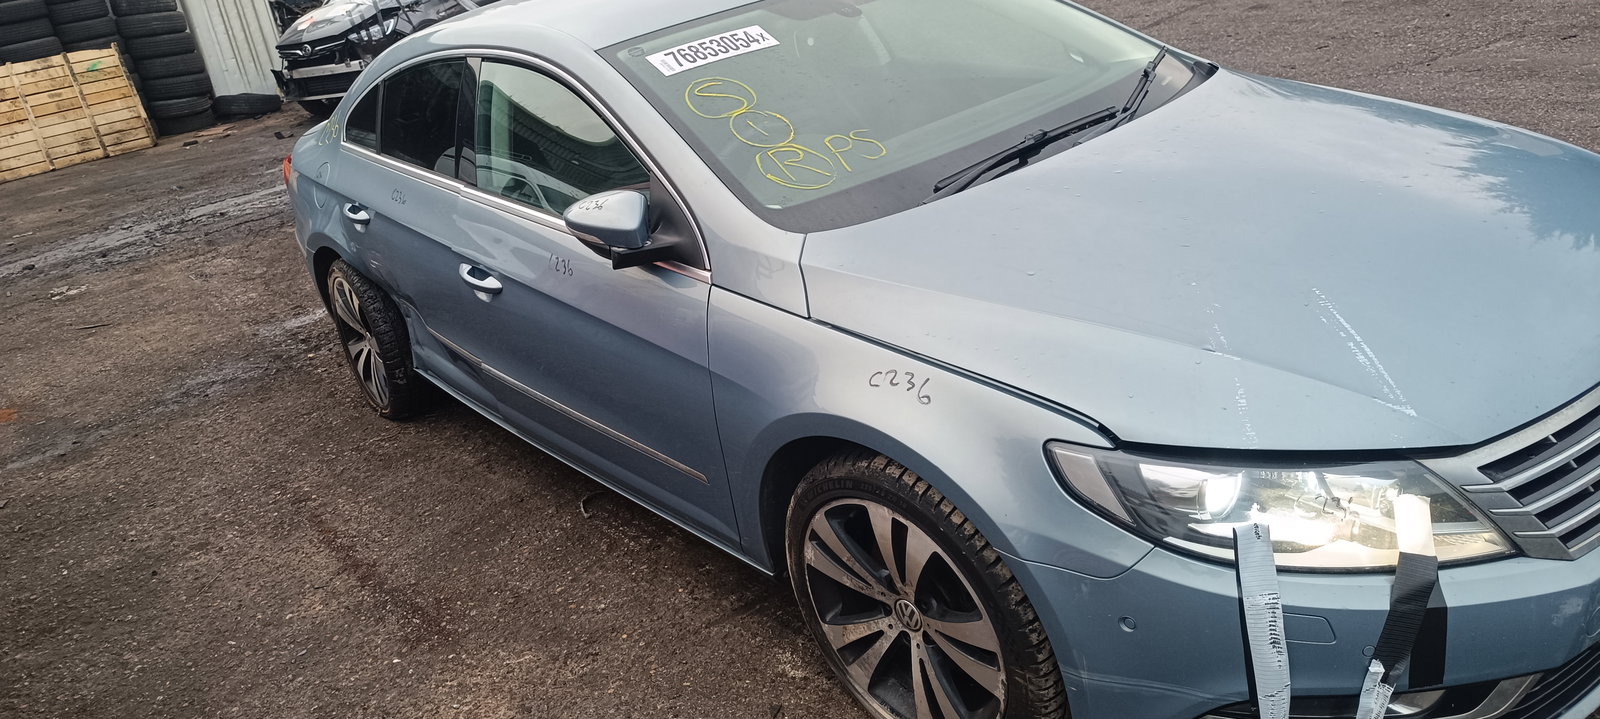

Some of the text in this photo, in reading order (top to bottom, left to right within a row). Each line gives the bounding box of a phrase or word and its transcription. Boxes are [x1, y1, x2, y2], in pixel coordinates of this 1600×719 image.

[664, 30, 761, 67] 76853054
[767, 128, 887, 182] R PS
[868, 369, 932, 405] C236
